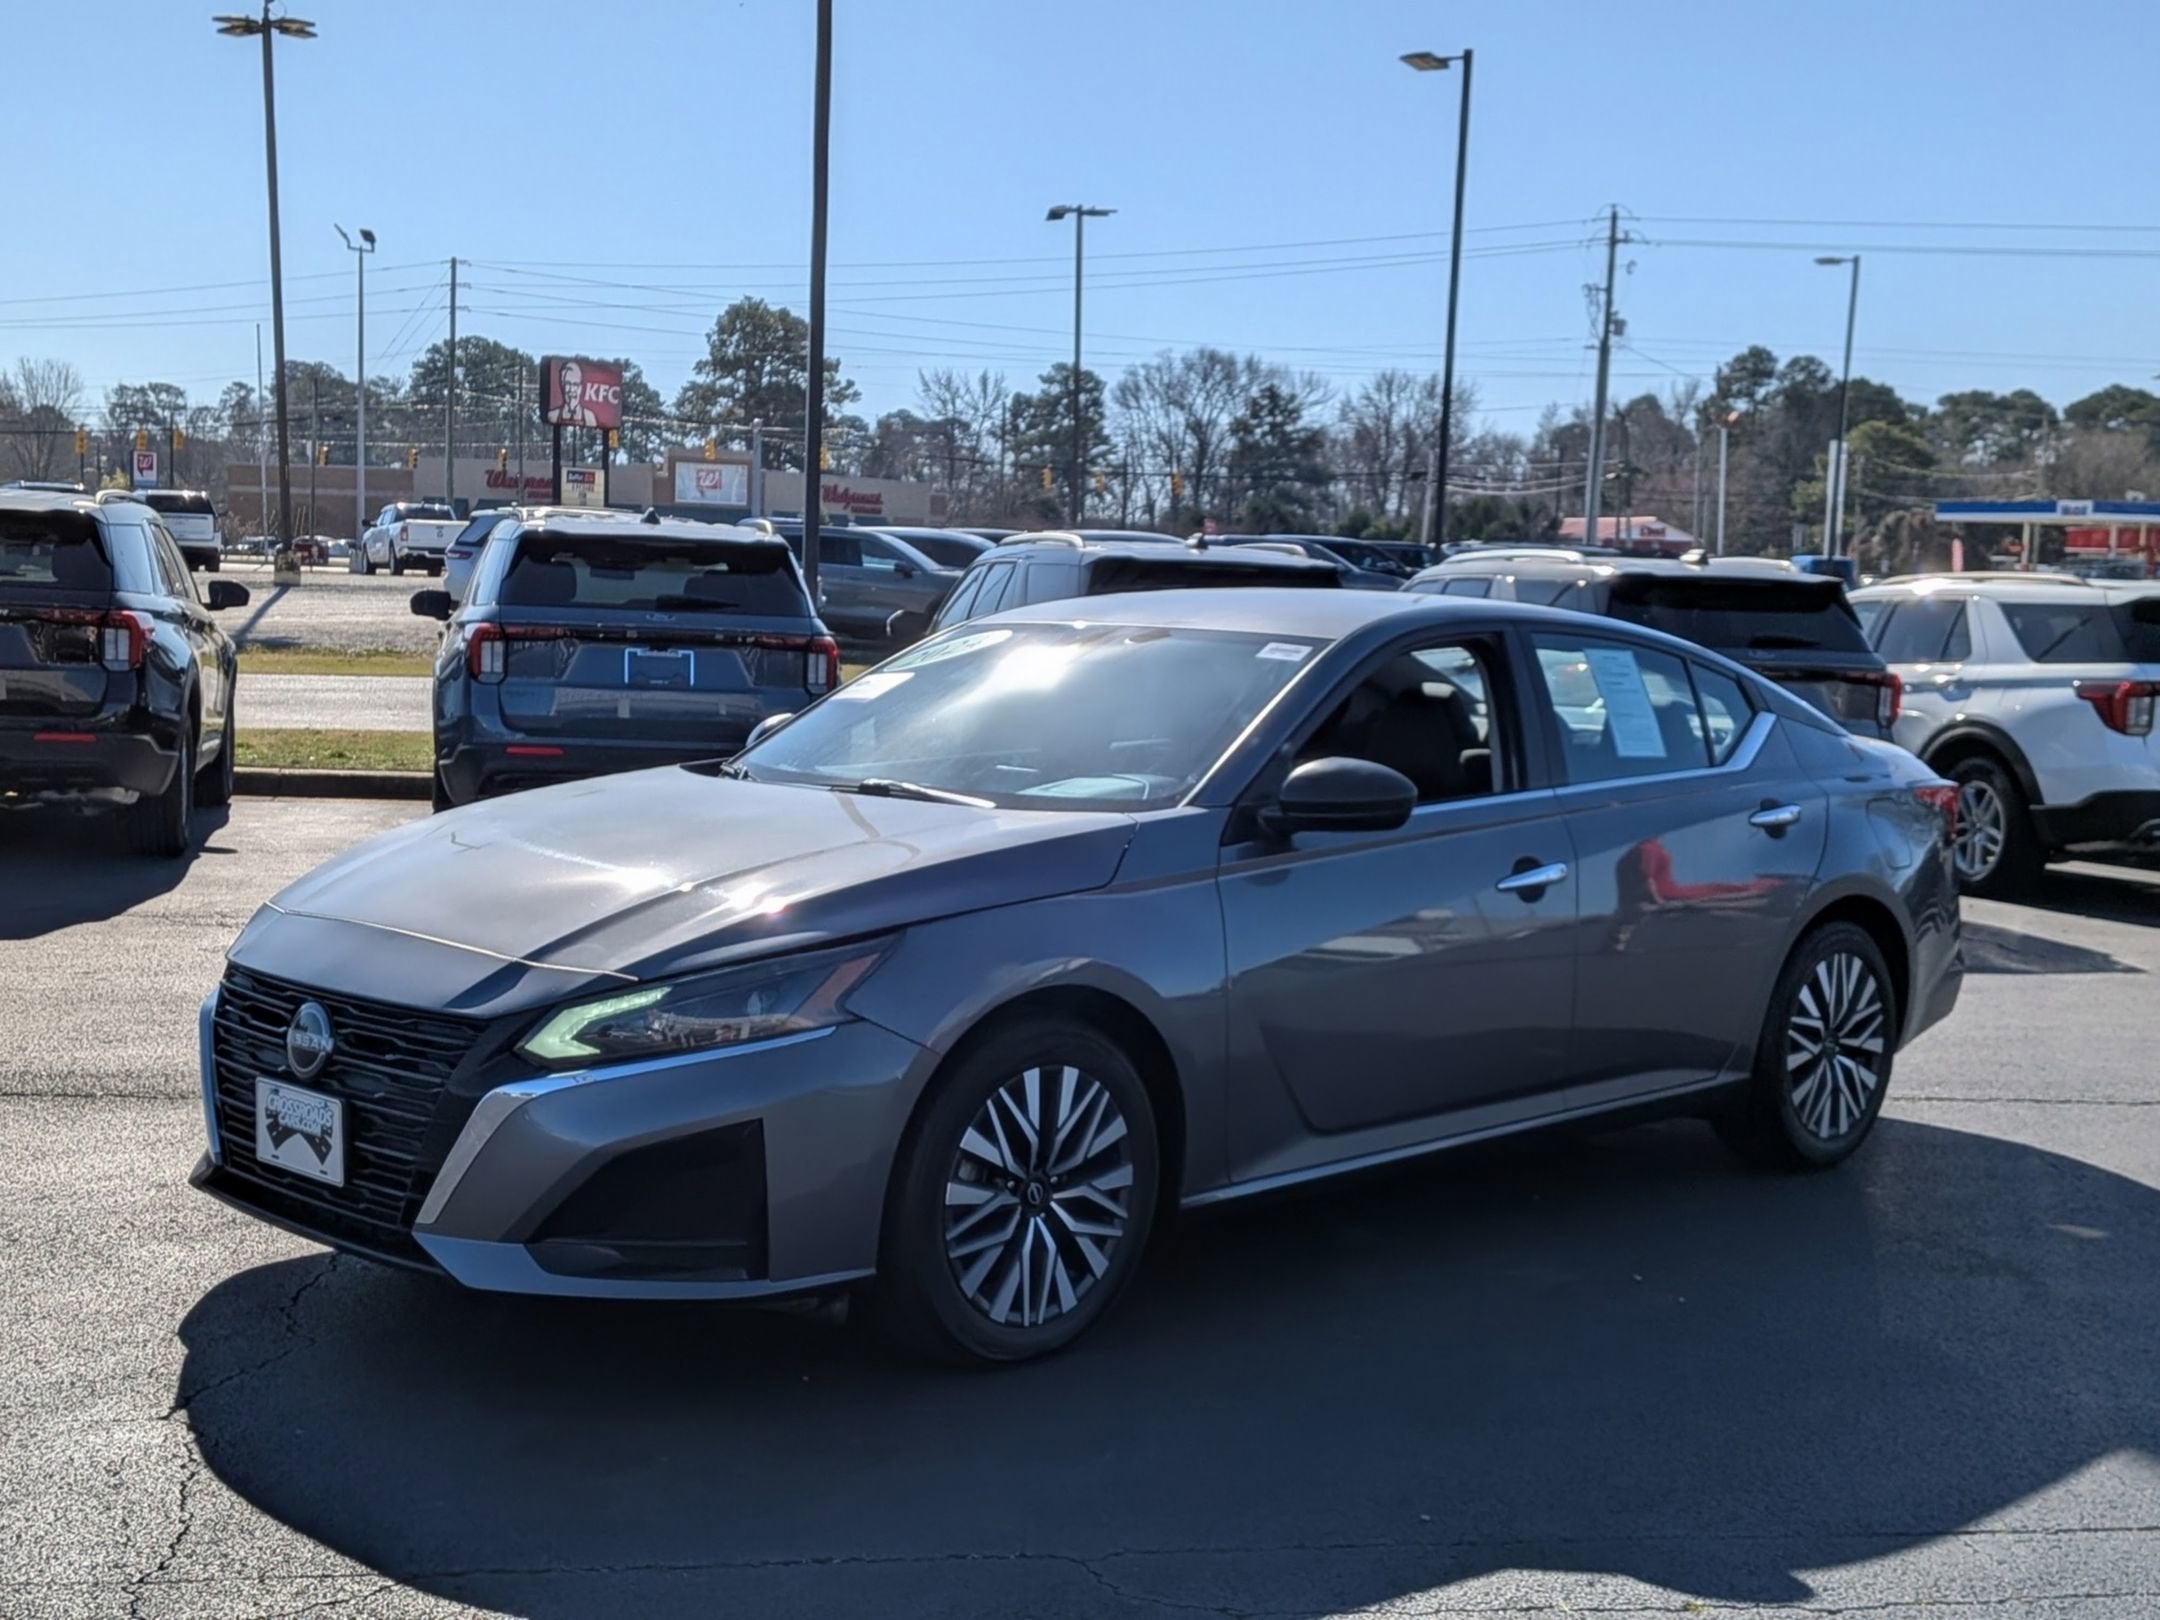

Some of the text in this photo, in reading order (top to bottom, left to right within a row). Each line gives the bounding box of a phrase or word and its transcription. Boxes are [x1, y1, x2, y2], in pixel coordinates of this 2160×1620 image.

[584, 382, 621, 405] KFC
[288, 1030, 335, 1053] SSAN
[267, 1094, 334, 1128] CROSSROADS
